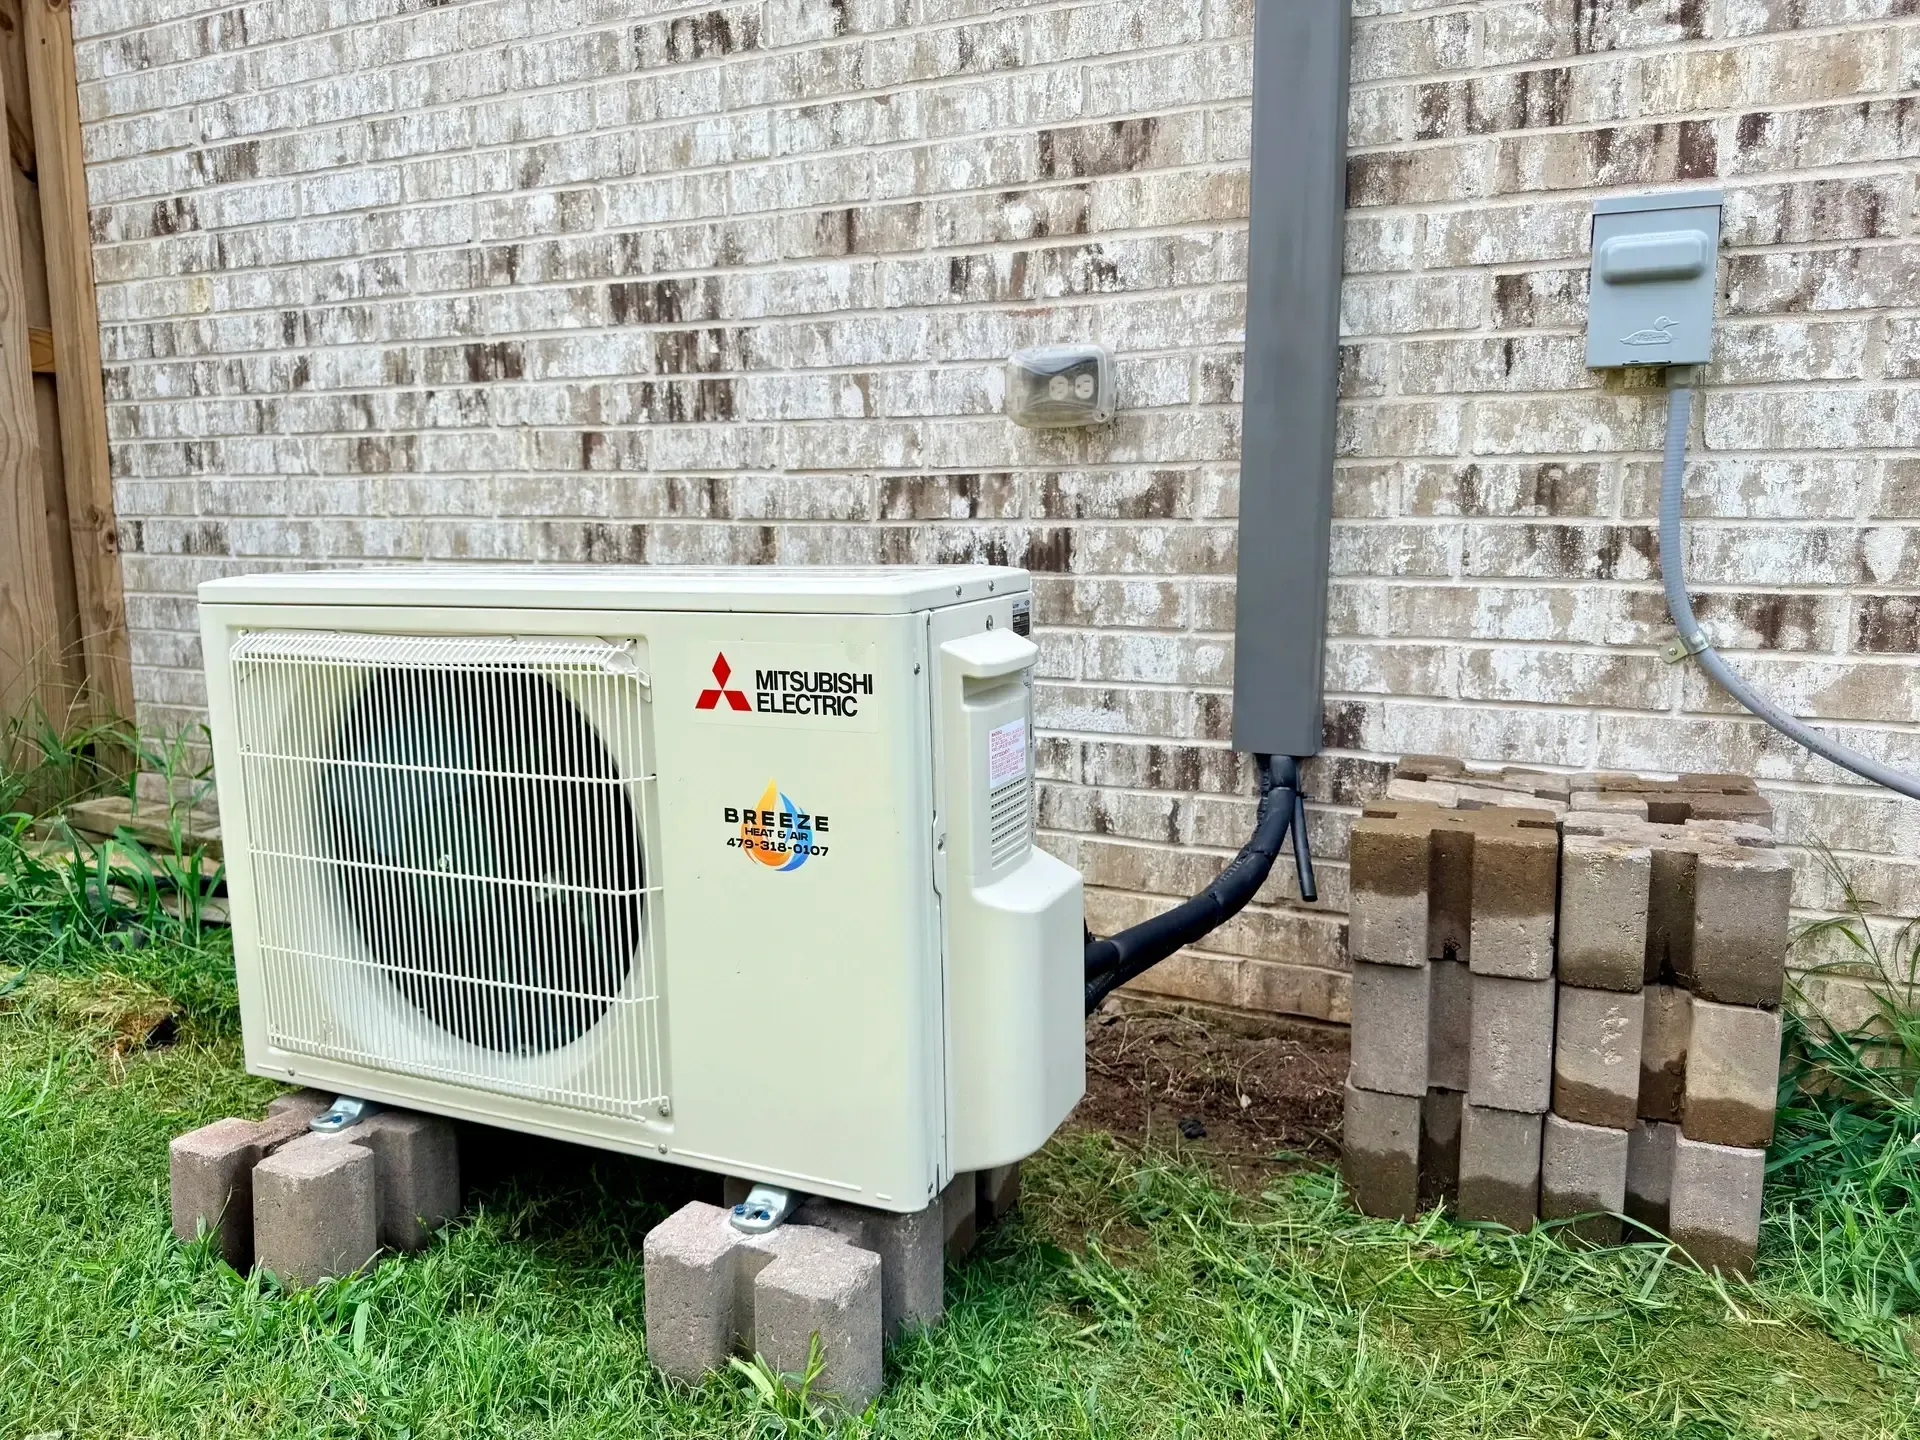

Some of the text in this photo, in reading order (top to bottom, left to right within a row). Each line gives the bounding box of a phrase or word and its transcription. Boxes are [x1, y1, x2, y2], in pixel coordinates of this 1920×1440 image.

[755, 670, 873, 695] MITSUBISHI
[756, 692, 858, 717] ELECTRIC
[724, 807, 829, 832] BREEZE
[745, 827, 809, 841] HEAT & AIR
[726, 837, 829, 857] 479-318-0107
